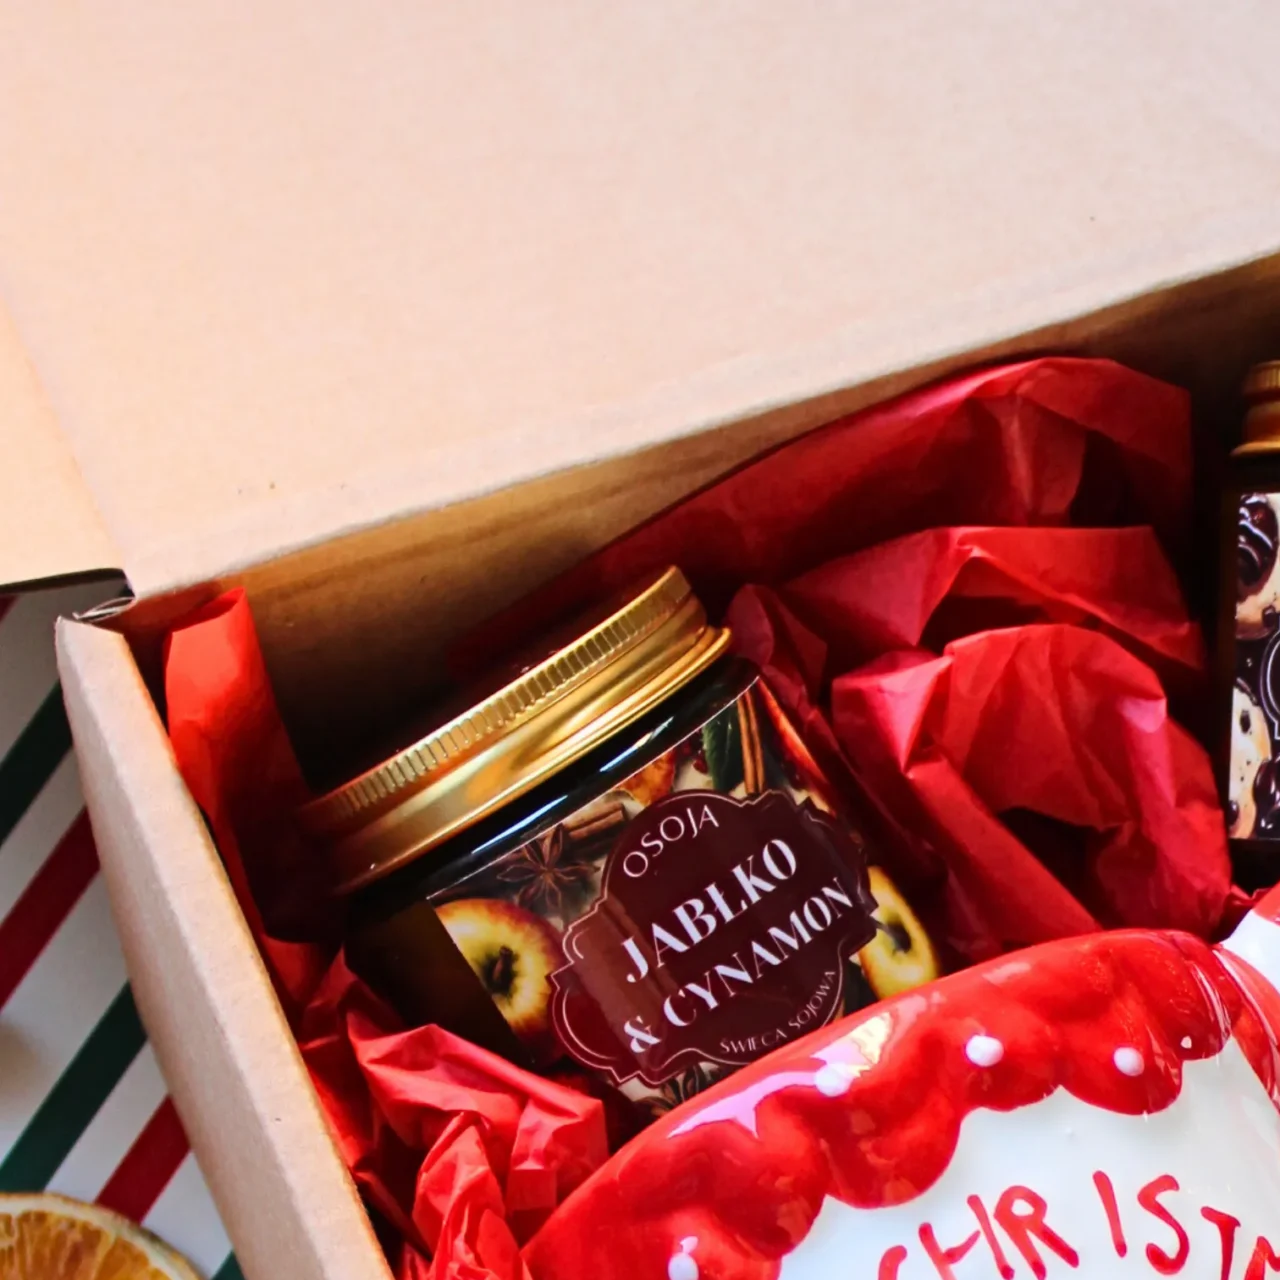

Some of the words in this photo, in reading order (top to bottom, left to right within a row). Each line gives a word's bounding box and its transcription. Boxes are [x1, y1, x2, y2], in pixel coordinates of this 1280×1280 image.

[623, 804, 719, 878] OSOJA
[621, 839, 797, 983] JABŁKO
[623, 1014, 661, 1053] &
[662, 877, 853, 1027] CYNAMON
[720, 1027, 787, 1054] ŚWIECA
[788, 970, 835, 1029] SOJOWA
